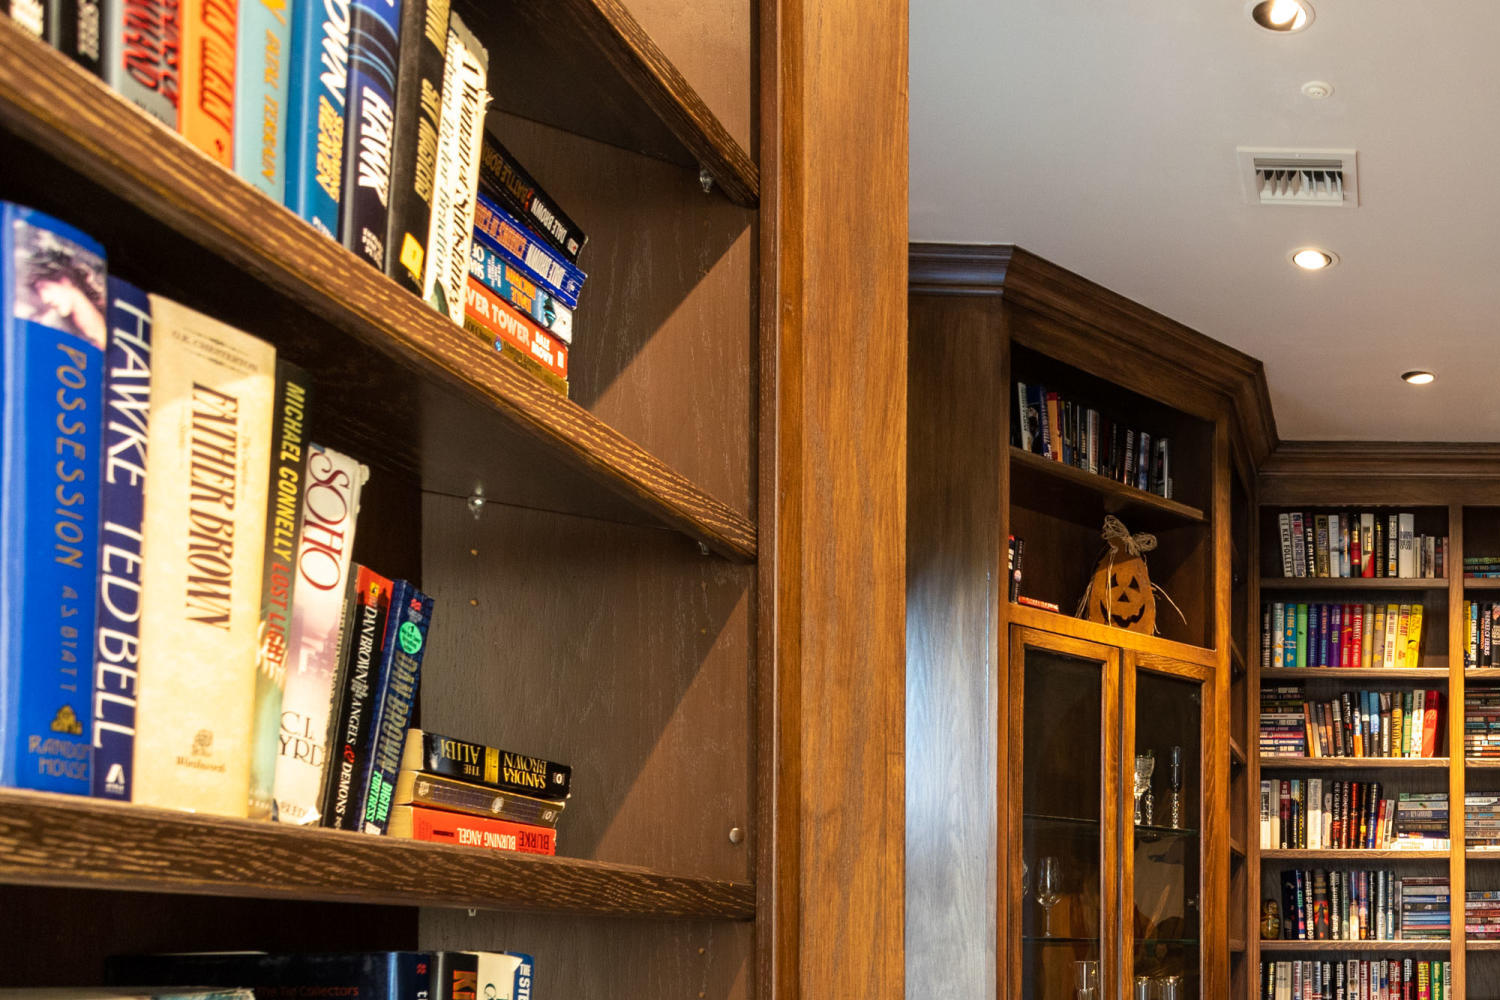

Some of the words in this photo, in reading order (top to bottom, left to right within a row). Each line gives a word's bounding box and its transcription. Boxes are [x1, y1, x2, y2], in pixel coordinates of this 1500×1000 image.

[356, 85, 398, 207] HAWK
[492, 304, 530, 348] TOWER
[106, 298, 152, 487] HAWKE
[191, 382, 238, 511] FATHER
[280, 382, 306, 463] MICHAEL
[54, 343, 87, 569] POSSESSION
[273, 465, 299, 562] CONNELLY
[299, 452, 350, 591] SOHO
[99, 521, 143, 623] TED
[185, 508, 235, 632] BROWN
[363, 604, 378, 632] DAN
[357, 632, 374, 681] BROWN
[92, 626, 140, 748] BELL
[348, 698, 362, 746] ANGELS
[440, 738, 481, 766] ALIBI
[504, 752, 548, 775] BROWN
[504, 766, 547, 790] SANDRA
[336, 761, 352, 815] DEMONS
[456, 827, 483, 845] ANGEL
[484, 832, 517, 851] BURNING
[519, 830, 550, 851] BURKE
